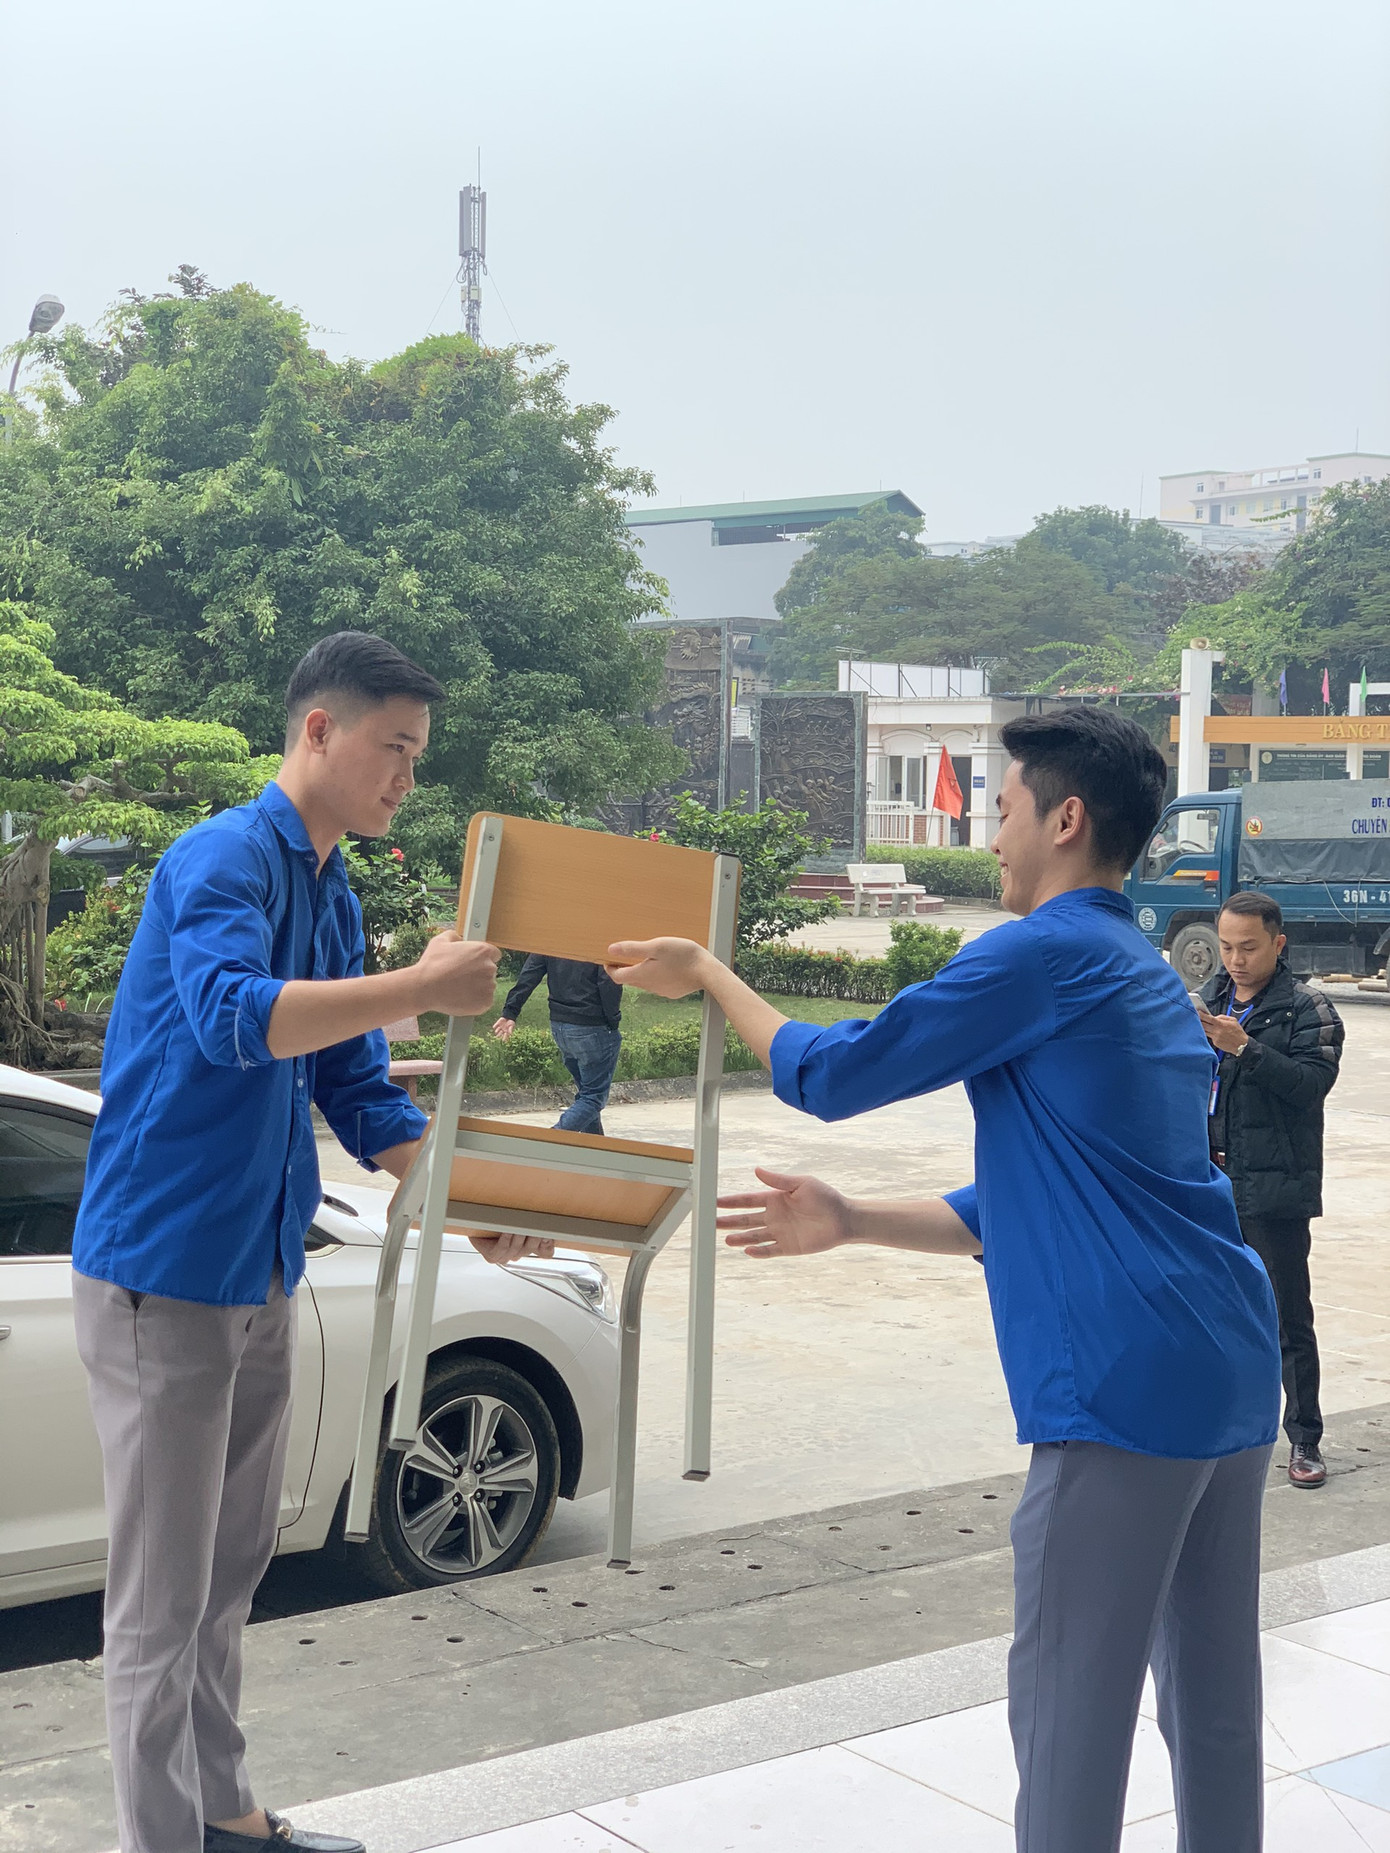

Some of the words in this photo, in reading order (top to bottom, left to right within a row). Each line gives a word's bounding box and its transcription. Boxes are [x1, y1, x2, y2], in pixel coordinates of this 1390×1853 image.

[1322, 718, 1372, 740] BẢNG
[1376, 723, 1390, 740] T
[1371, 797, 1385, 808] ĐT:
[1351, 815, 1388, 834] CHUYÊN
[1343, 889, 1368, 903] 36N
